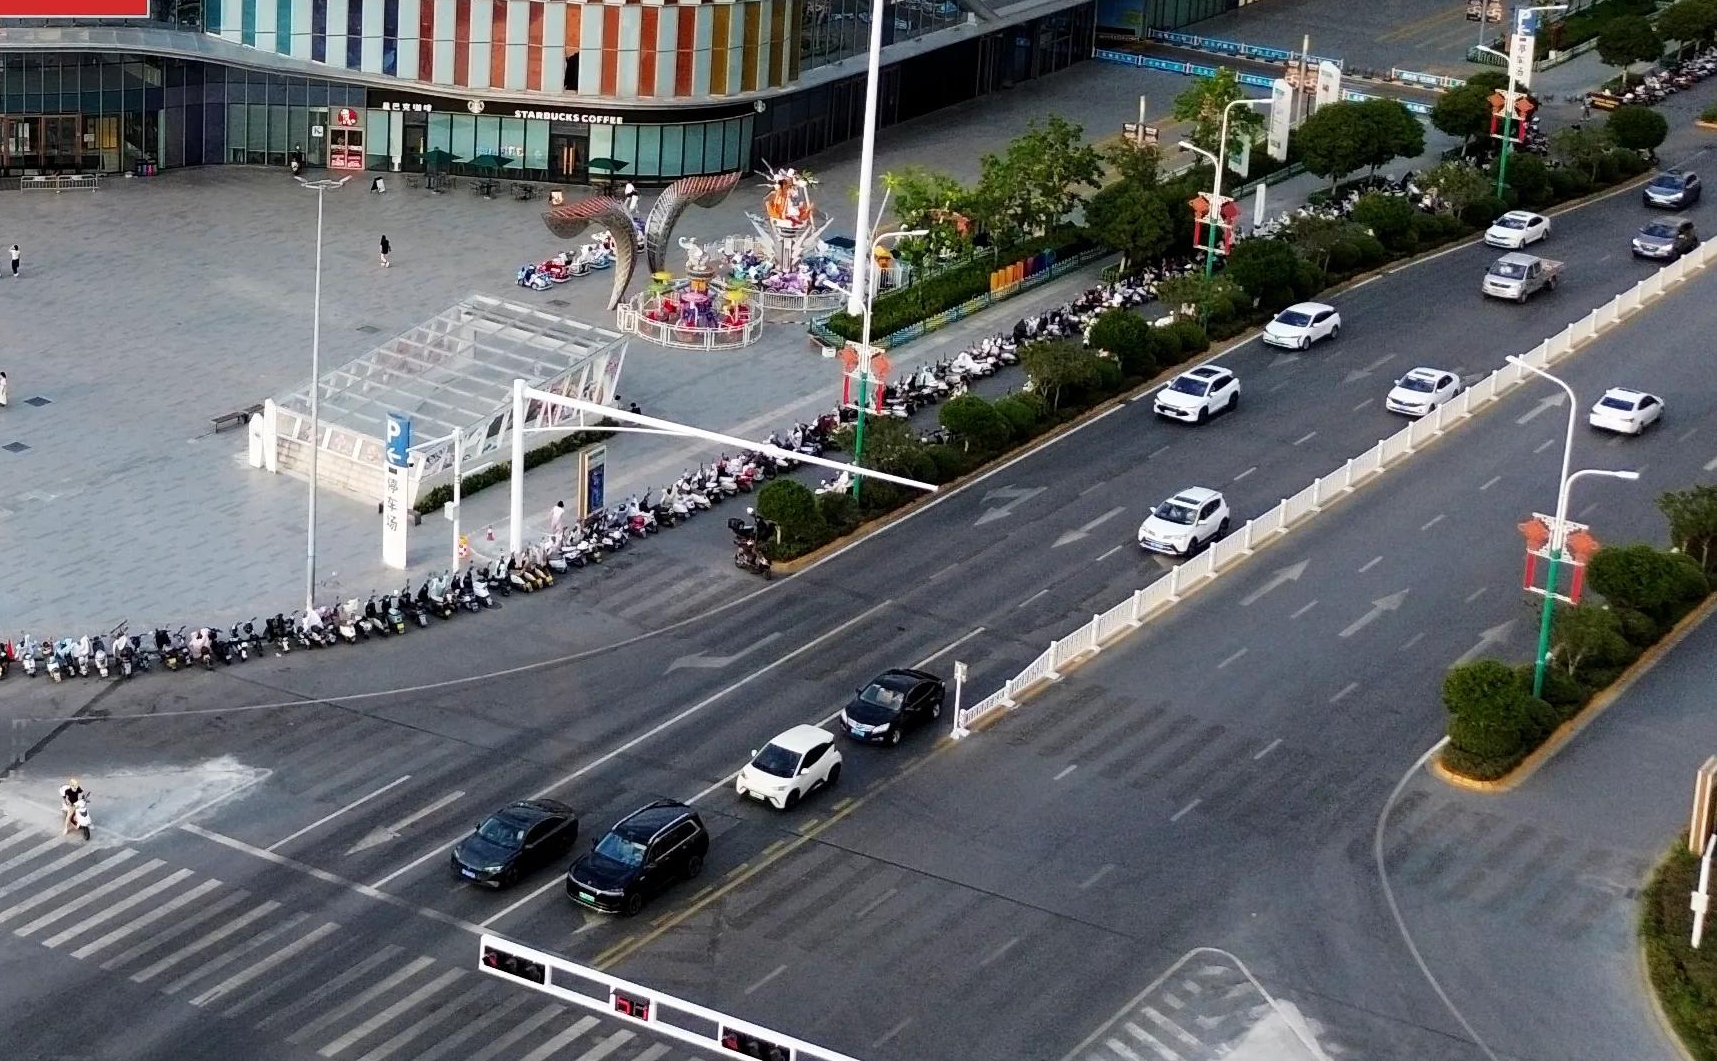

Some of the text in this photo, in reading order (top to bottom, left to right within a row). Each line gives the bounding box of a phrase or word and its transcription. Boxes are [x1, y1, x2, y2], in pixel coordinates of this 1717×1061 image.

[514, 109, 624, 125] STARBUCKS COFFEE
[387, 419, 401, 443] P
[386, 478, 399, 532] 停车场
